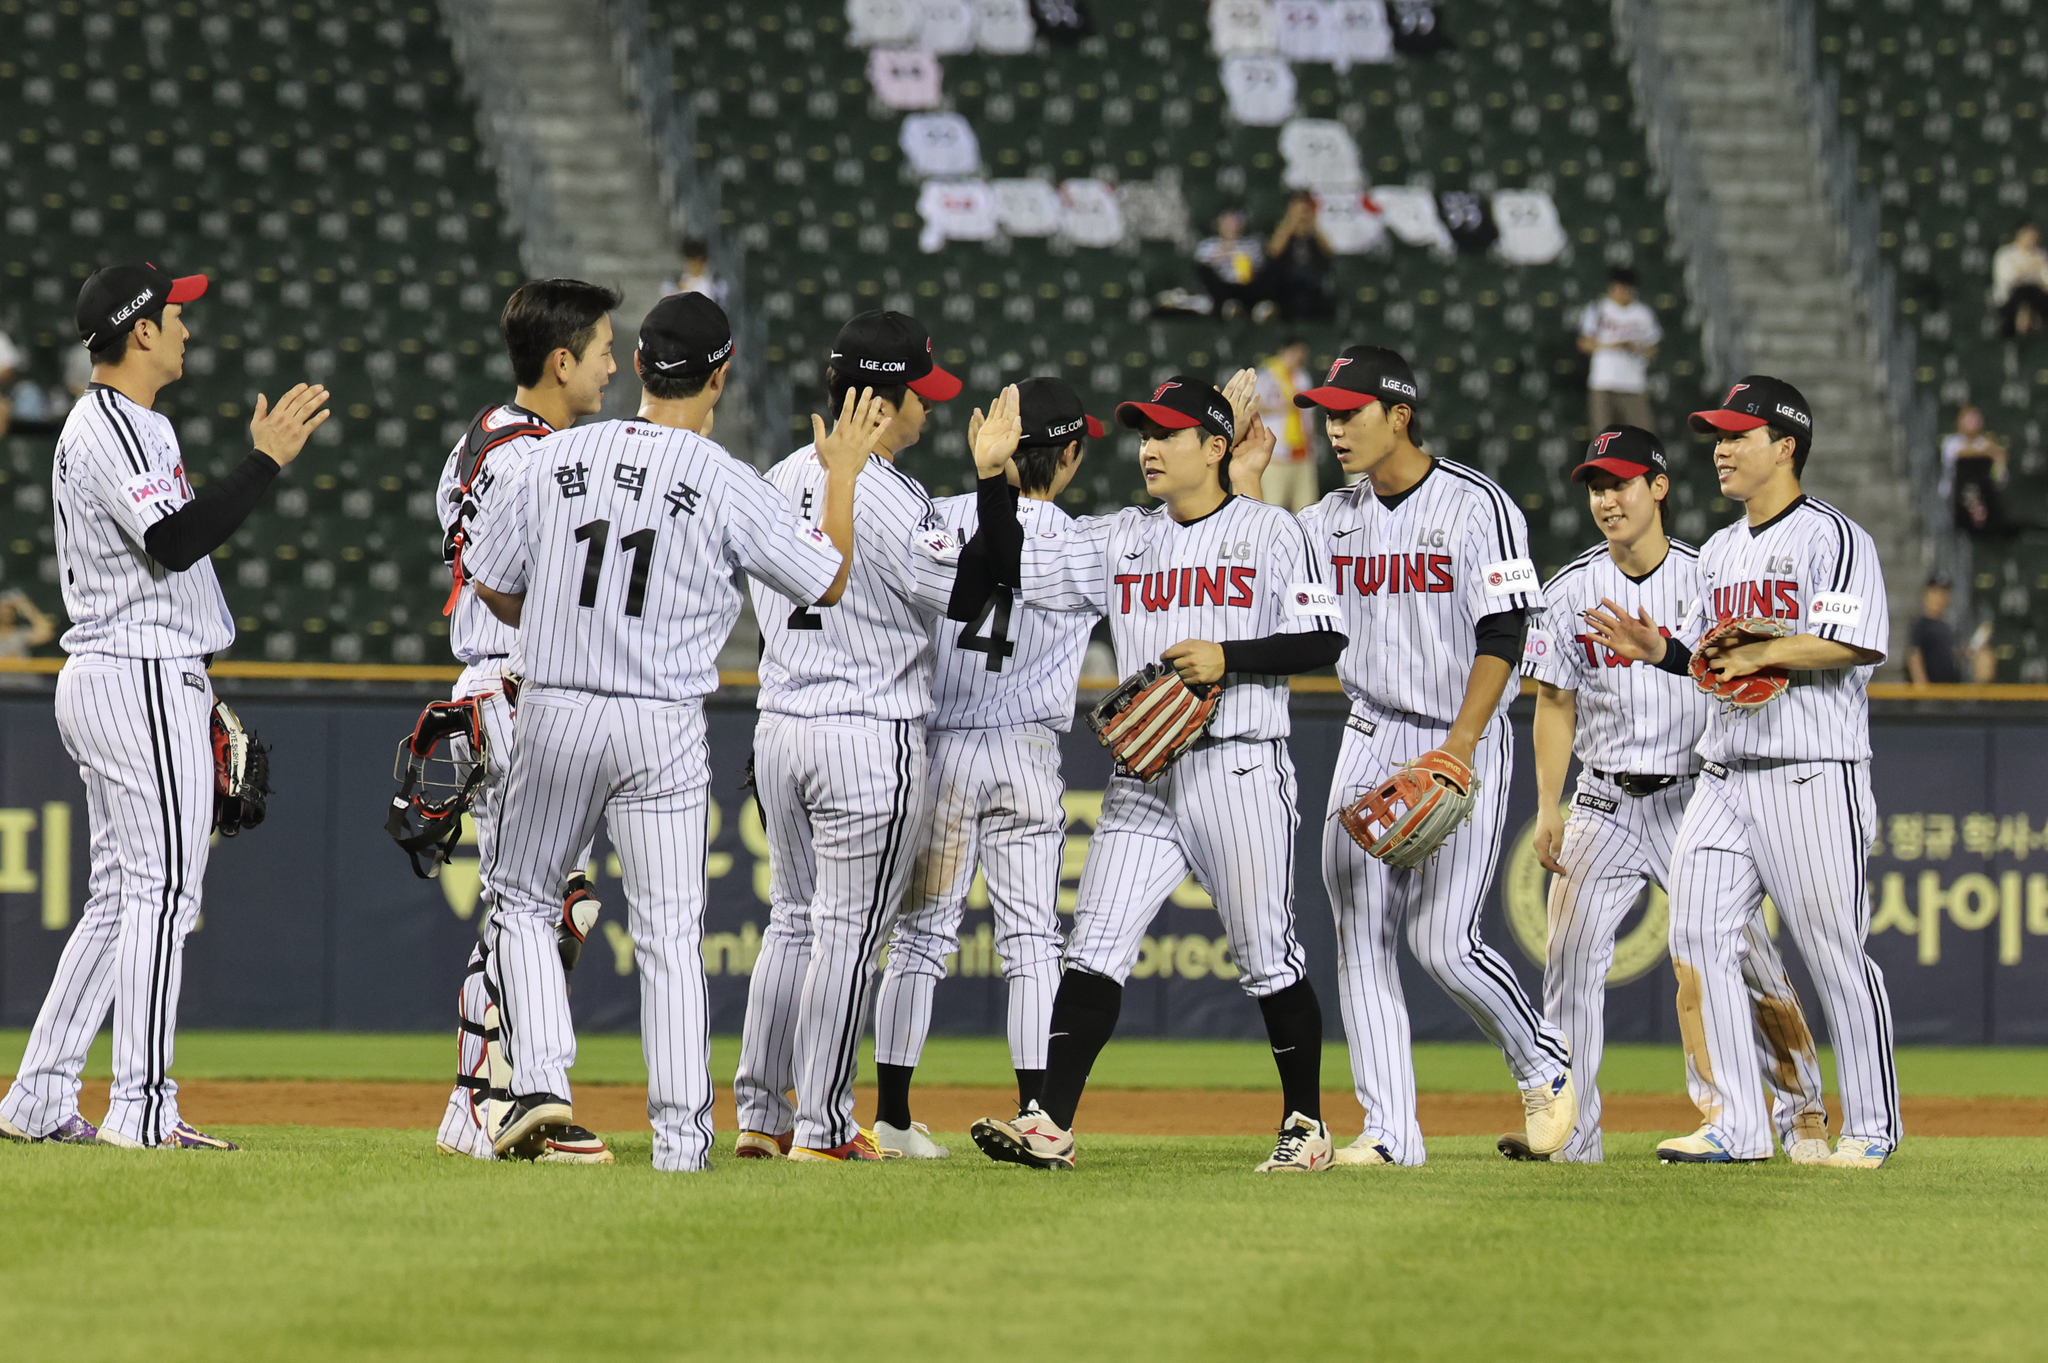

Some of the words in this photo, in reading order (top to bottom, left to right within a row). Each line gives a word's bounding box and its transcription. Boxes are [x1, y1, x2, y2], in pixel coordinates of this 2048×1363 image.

[110, 288, 154, 327] LGE.COM
[859, 358, 906, 373] LGE.COM
[1746, 401, 1760, 416] 51
[1048, 416, 1084, 439] LGE.COM
[128, 478, 173, 504] ixio
[929, 533, 955, 552] ixio
[1419, 527, 1445, 548] LG
[1219, 540, 1251, 561] LG
[574, 518, 657, 618] 11
[1331, 553, 1454, 597] TWINS
[1767, 555, 1793, 574] LG
[1114, 565, 1257, 615] TWINS
[1711, 579, 1800, 620] WINS
[957, 585, 1015, 673] 4
[1431, 757, 1462, 776] Wilson
[1887, 811, 1957, 861] 정규
